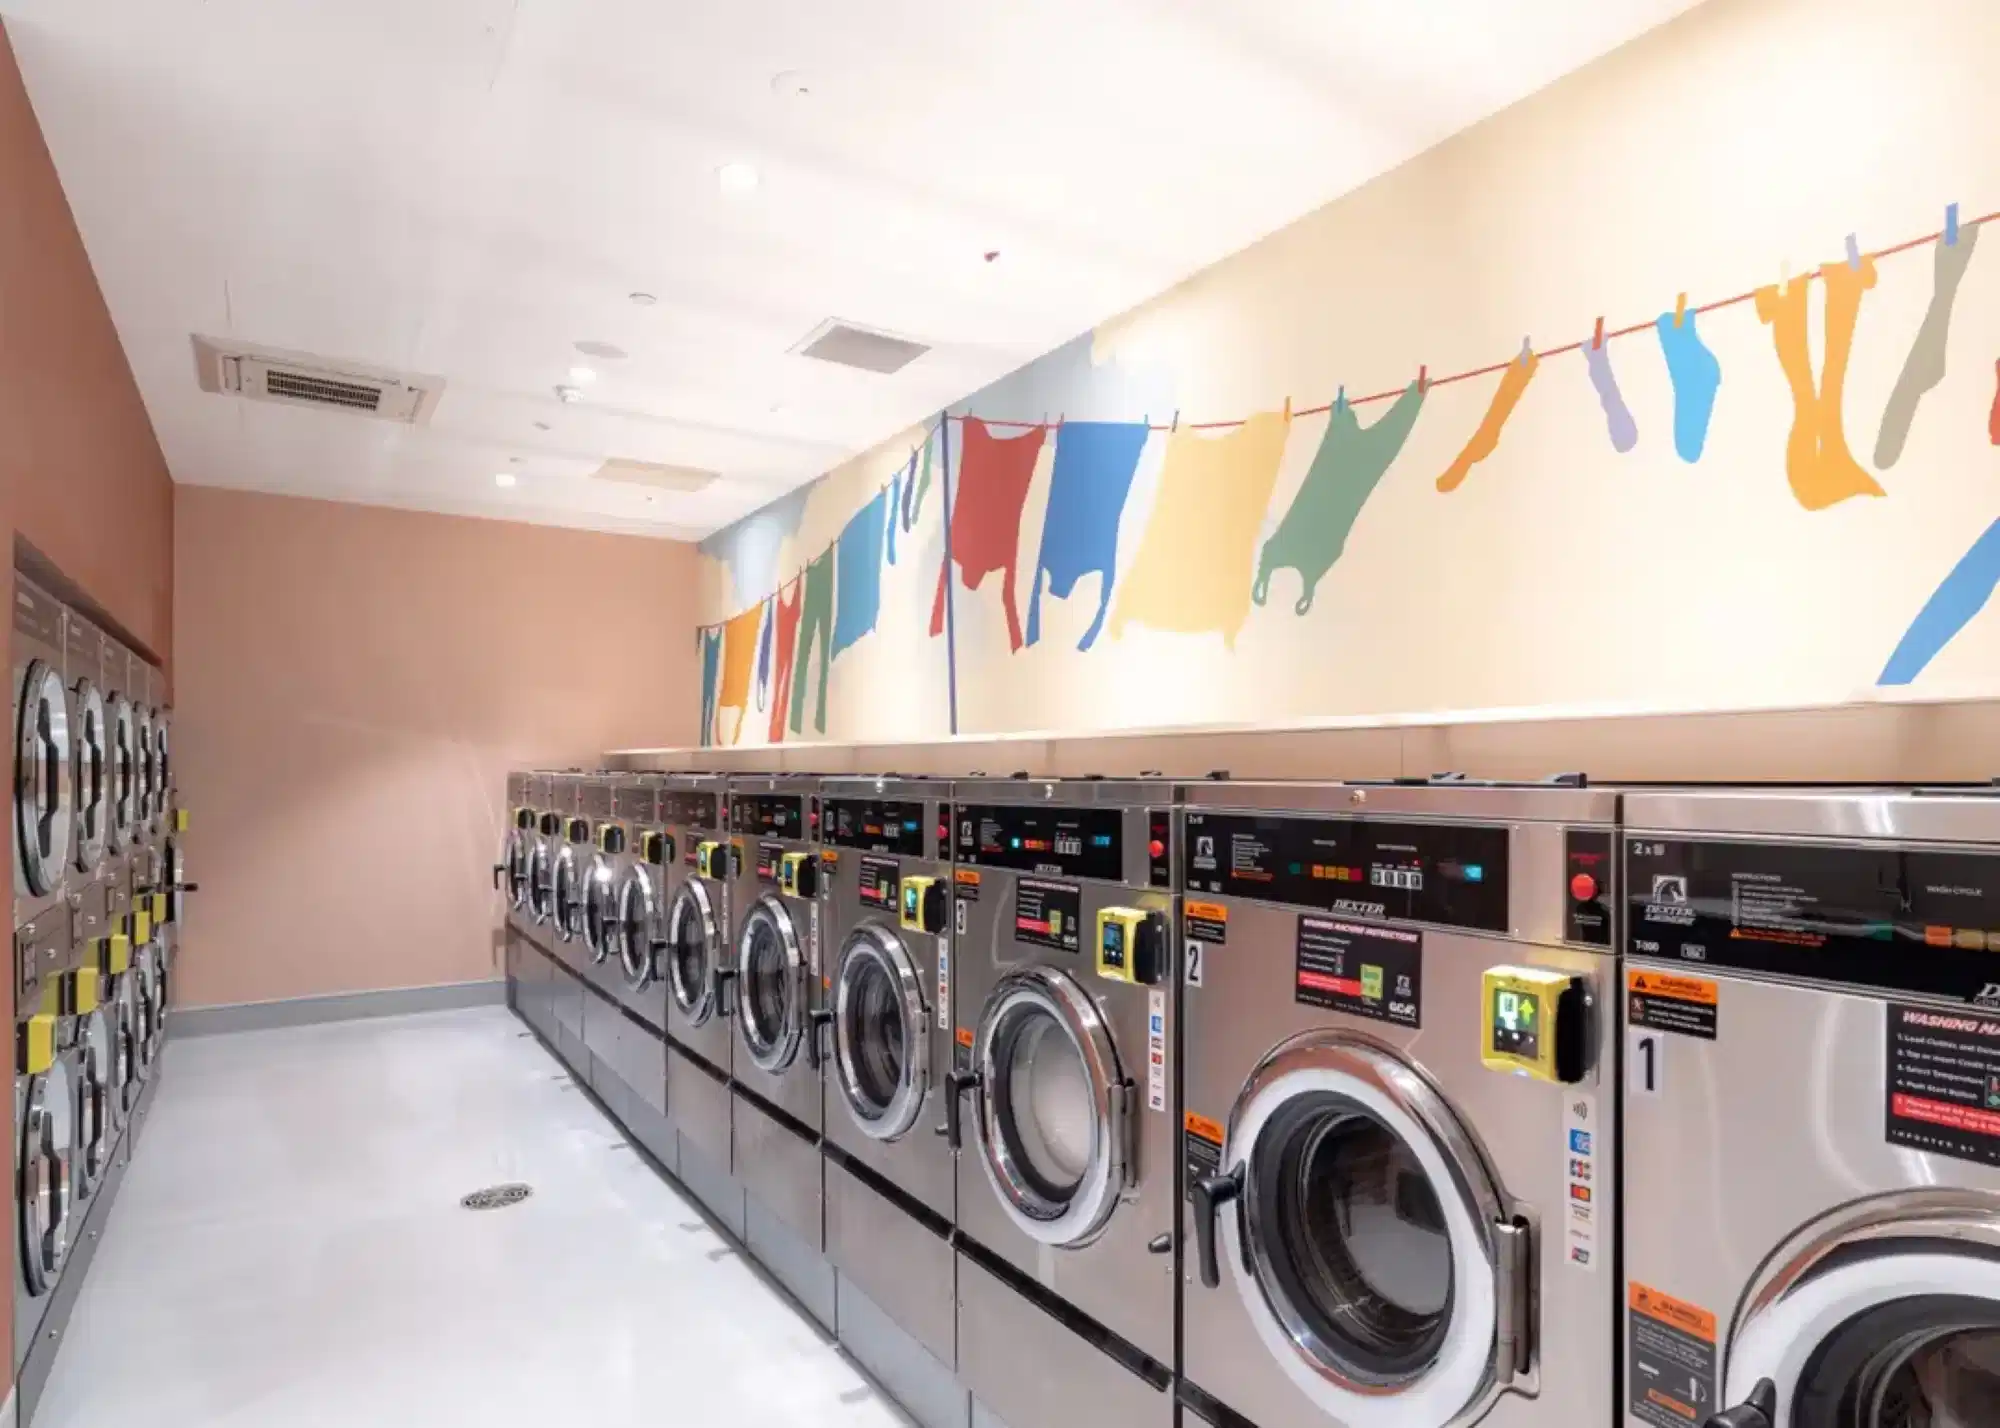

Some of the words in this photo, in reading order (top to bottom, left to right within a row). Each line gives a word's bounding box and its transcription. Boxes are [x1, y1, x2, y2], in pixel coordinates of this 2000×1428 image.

[1188, 945, 1200, 982] 2
[1902, 1011, 1979, 1031] WASHING
[1638, 1037, 1655, 1091] 1
